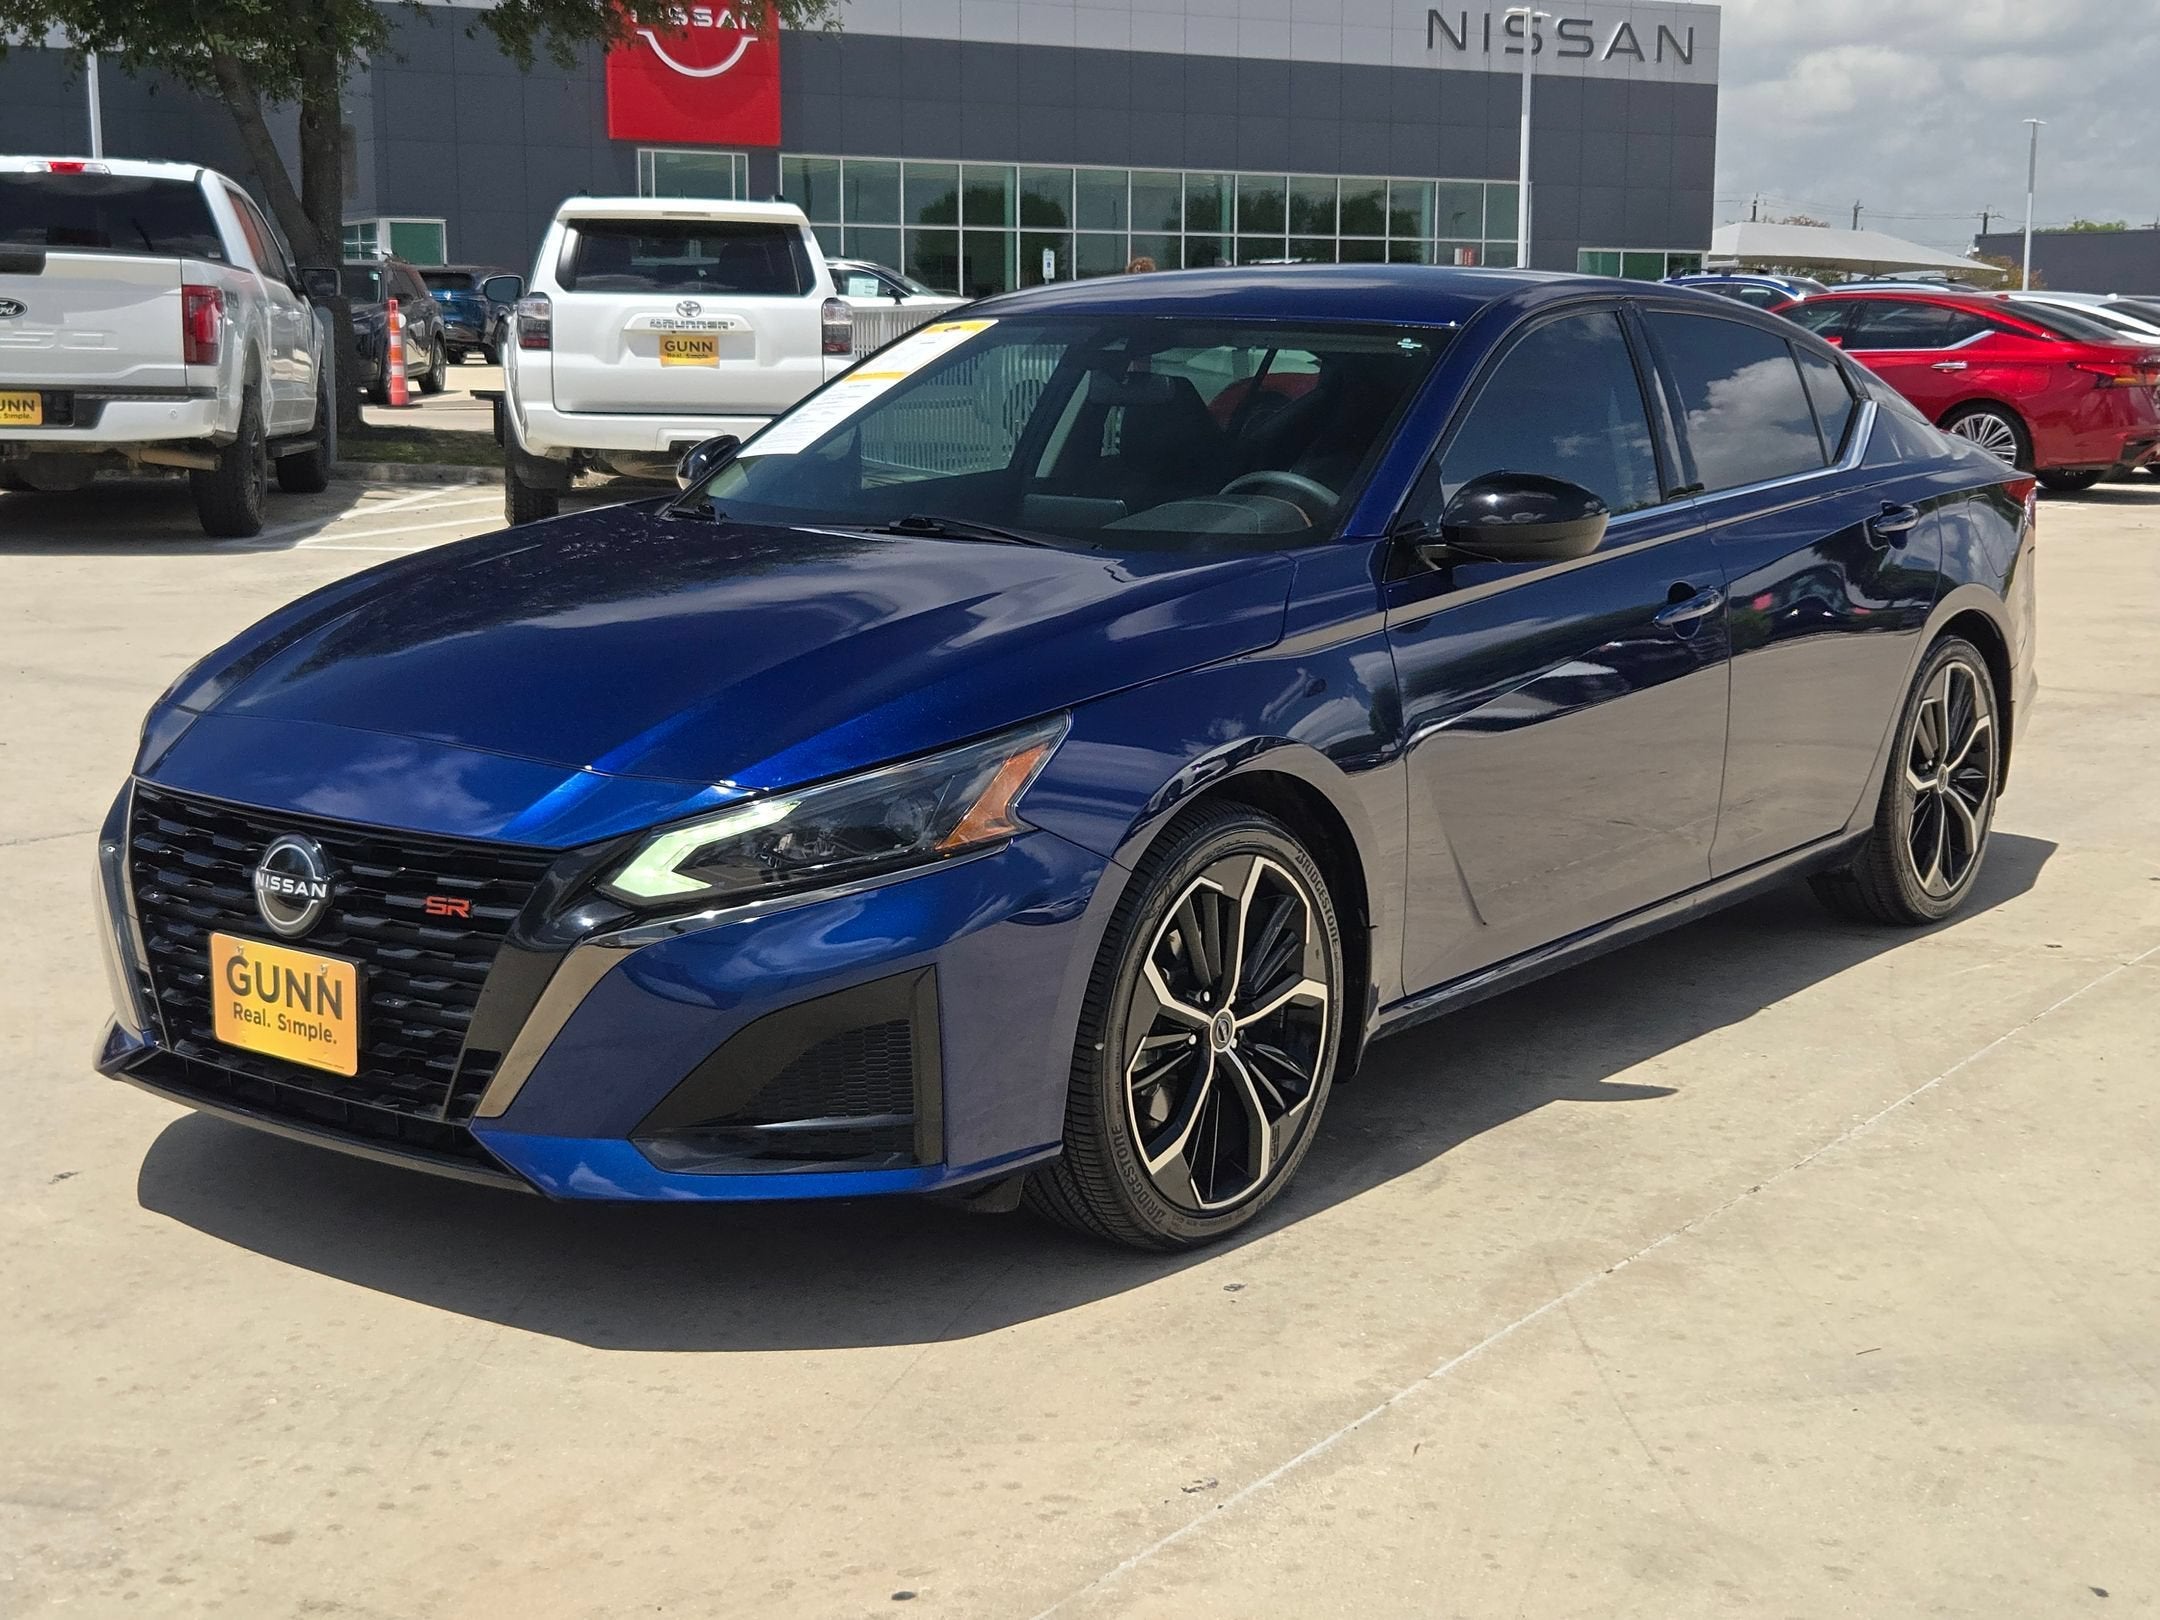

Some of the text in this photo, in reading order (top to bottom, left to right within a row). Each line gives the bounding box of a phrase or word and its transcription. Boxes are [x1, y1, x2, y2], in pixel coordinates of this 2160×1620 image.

[630, 7, 760, 29] SSA
[1427, 9, 1694, 64] NISSAN
[664, 340, 713, 352] GUNN
[0, 400, 35, 411] NN
[256, 872, 327, 898] NISSAN
[425, 896, 469, 918] SR
[226, 955, 342, 1020] GUNN
[233, 1001, 271, 1028] Real.
